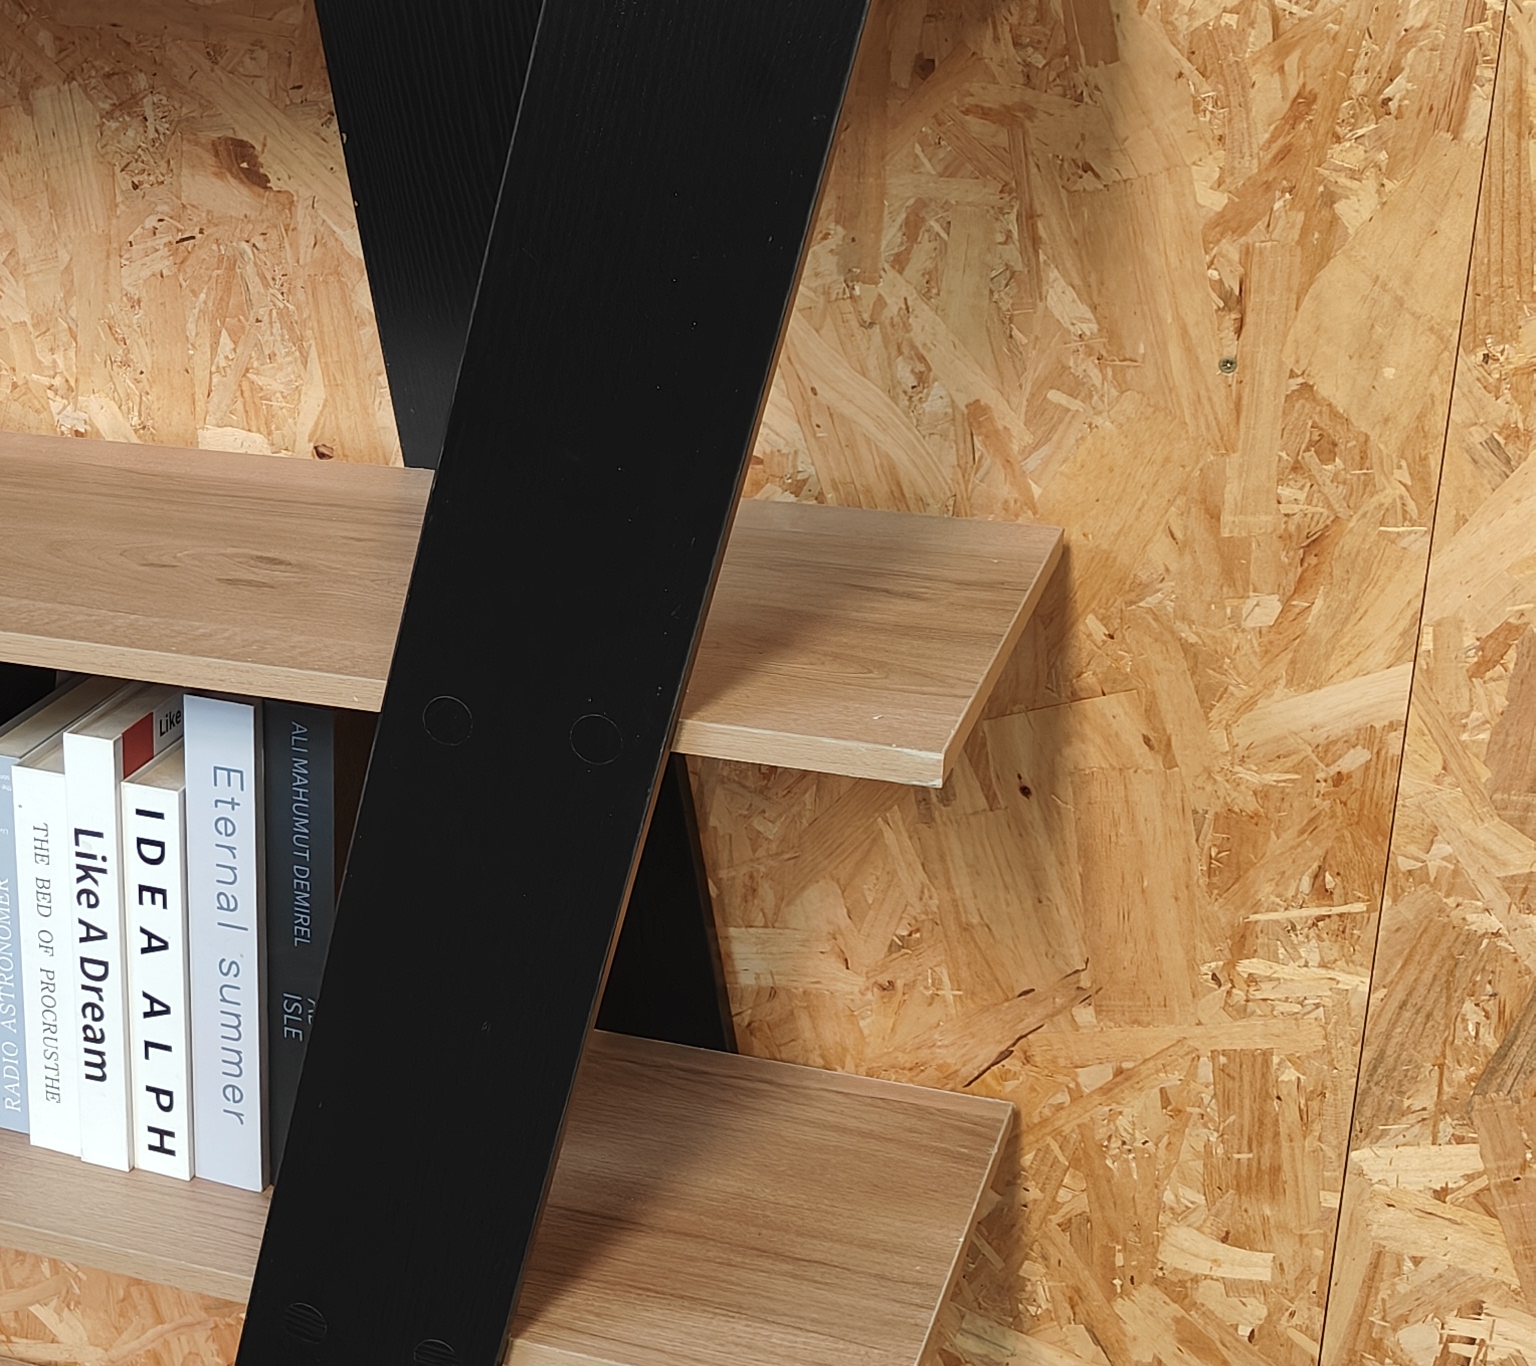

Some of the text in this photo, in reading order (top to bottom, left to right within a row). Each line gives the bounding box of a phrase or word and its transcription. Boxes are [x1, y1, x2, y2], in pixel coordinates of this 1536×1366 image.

[159, 710, 182, 737] Like
[291, 721, 311, 947] ALI MAHUMUT DEMIREL
[32, 822, 61, 1104] THE BED OF PROCRUSTHE
[74, 827, 110, 1083] Like A Dream
[213, 765, 249, 1125] Eternal summer
[283, 993, 303, 1042] ISLE
[1, 1040, 22, 1113] RADIO
